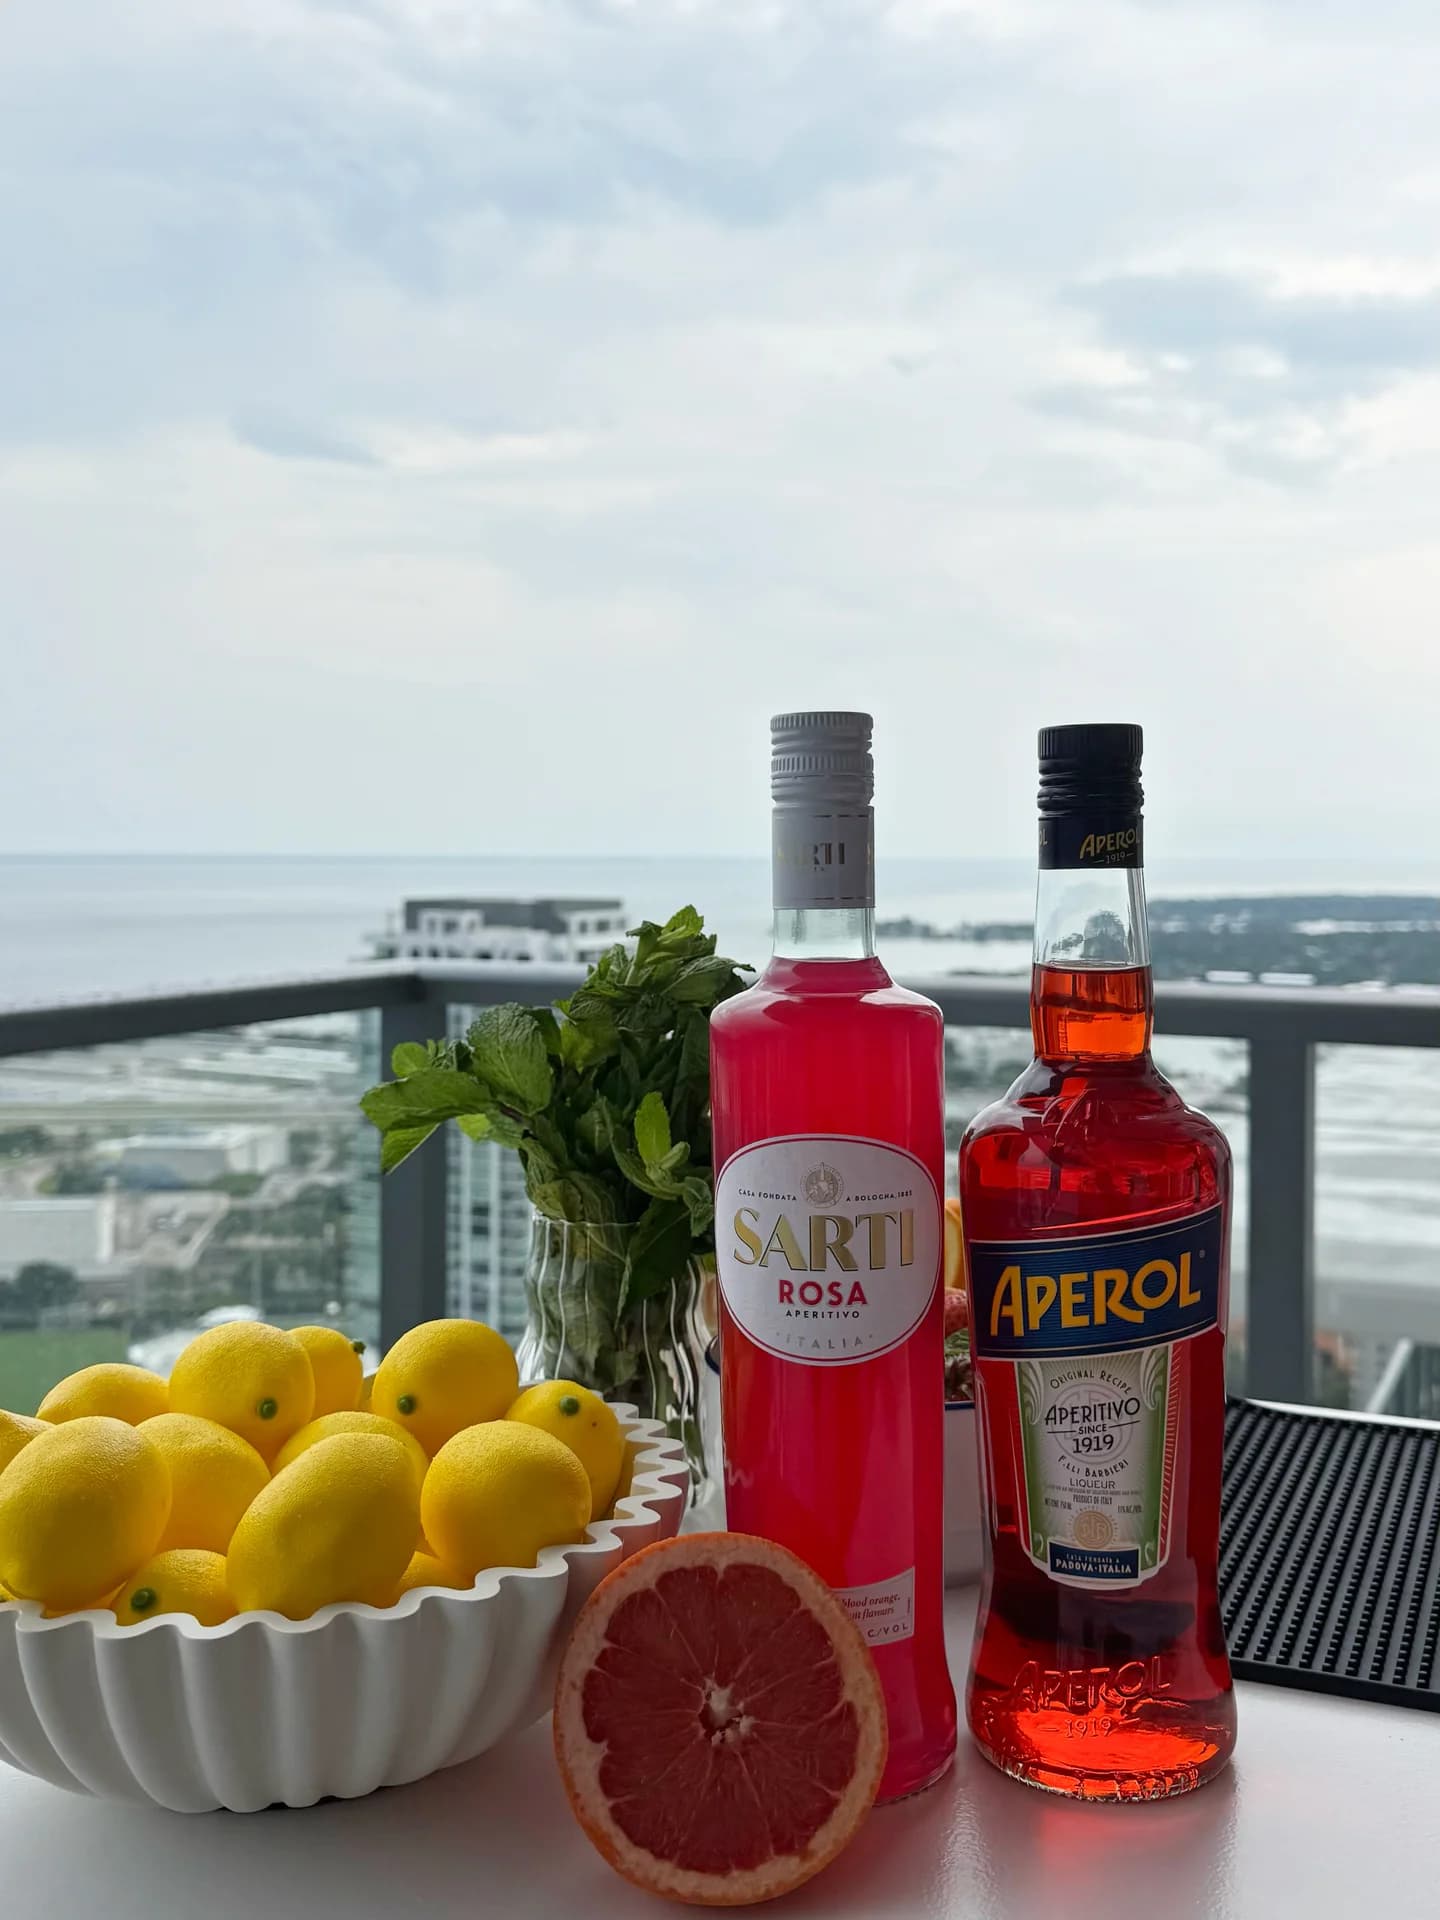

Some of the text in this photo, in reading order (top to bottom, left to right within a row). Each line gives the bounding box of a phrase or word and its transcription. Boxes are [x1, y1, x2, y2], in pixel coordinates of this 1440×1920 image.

[1079, 828, 1141, 859] APEROL
[1105, 852, 1127, 864] 1919
[738, 1188, 756, 1197] CASA
[758, 1192, 797, 1201] FONDATA
[733, 1207, 915, 1272] SARTI
[778, 1280, 868, 1306] ROSA
[990, 1251, 1201, 1337] APEROL
[785, 1310, 861, 1319] APERITIVO
[784, 1335, 864, 1349] ITALIA
[1050, 1370, 1132, 1395] ORIGINAL RECIPE
[1044, 1397, 1141, 1426] APERITIVO
[1078, 1423, 1108, 1435] SINCE
[1072, 1434, 1115, 1454] 1919
[1085, 1458, 1129, 1478] BARBIERI
[1069, 1478, 1116, 1490] LIQUEUR
[1064, 1716, 1112, 1739] 1919
